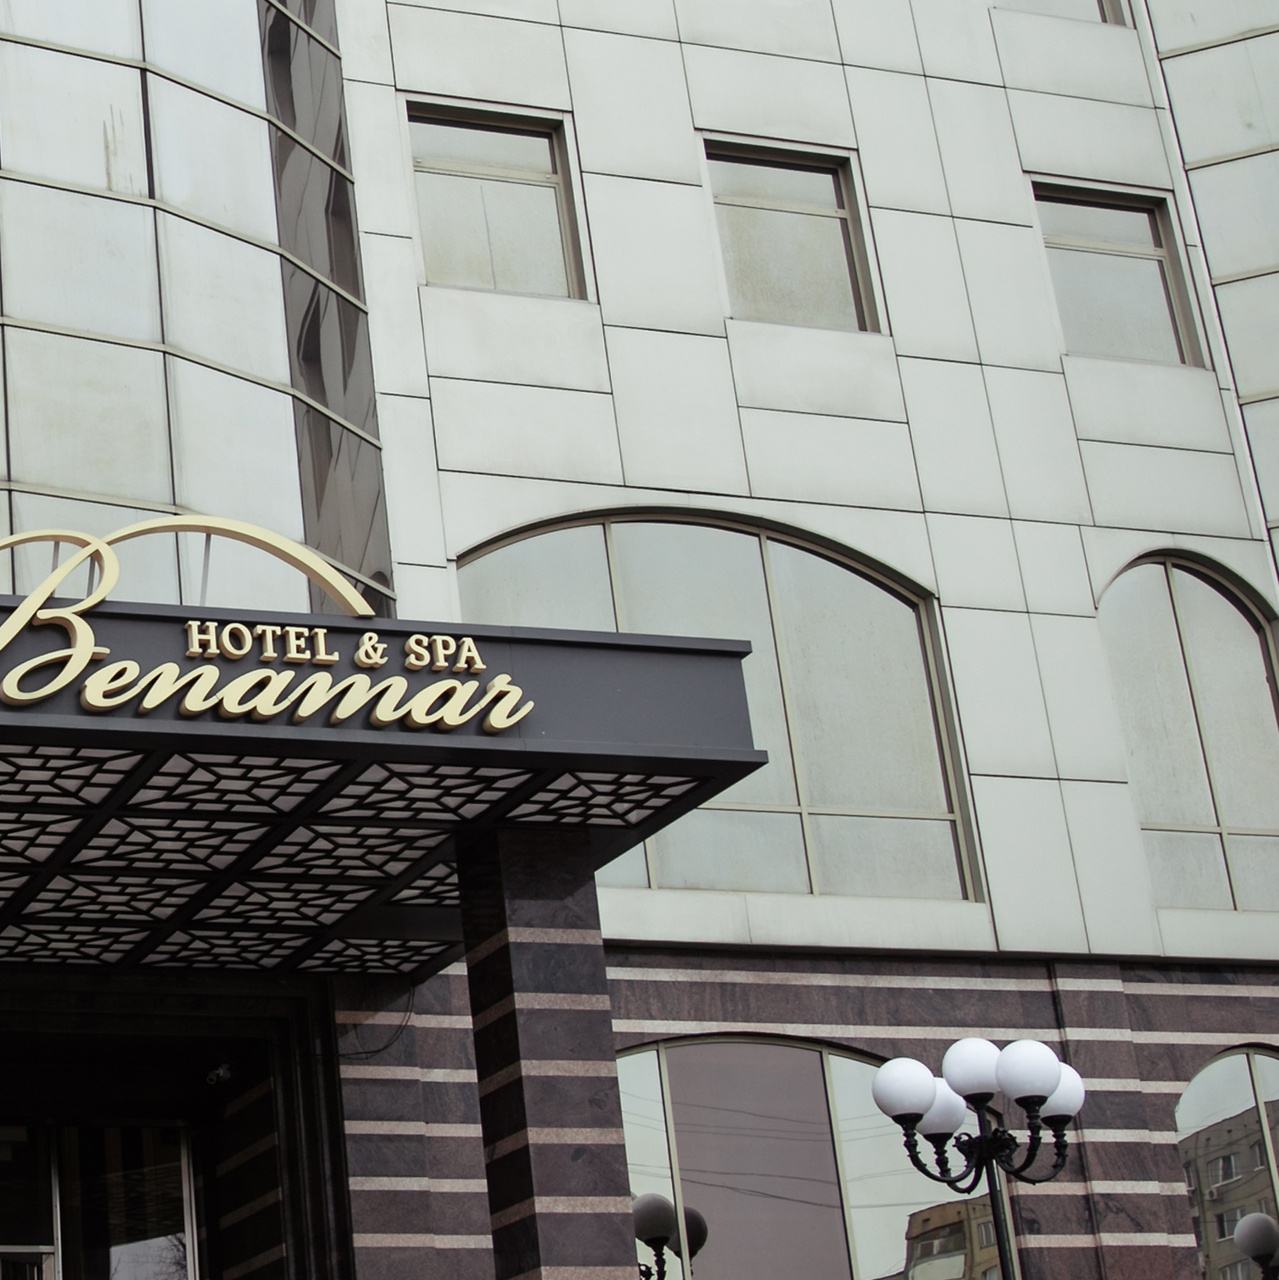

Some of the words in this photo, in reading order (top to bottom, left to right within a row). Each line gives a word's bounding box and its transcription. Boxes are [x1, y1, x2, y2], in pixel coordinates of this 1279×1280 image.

[185, 620, 339, 666] HOTEL
[353, 631, 389, 668] &
[404, 634, 487, 673] SPA
